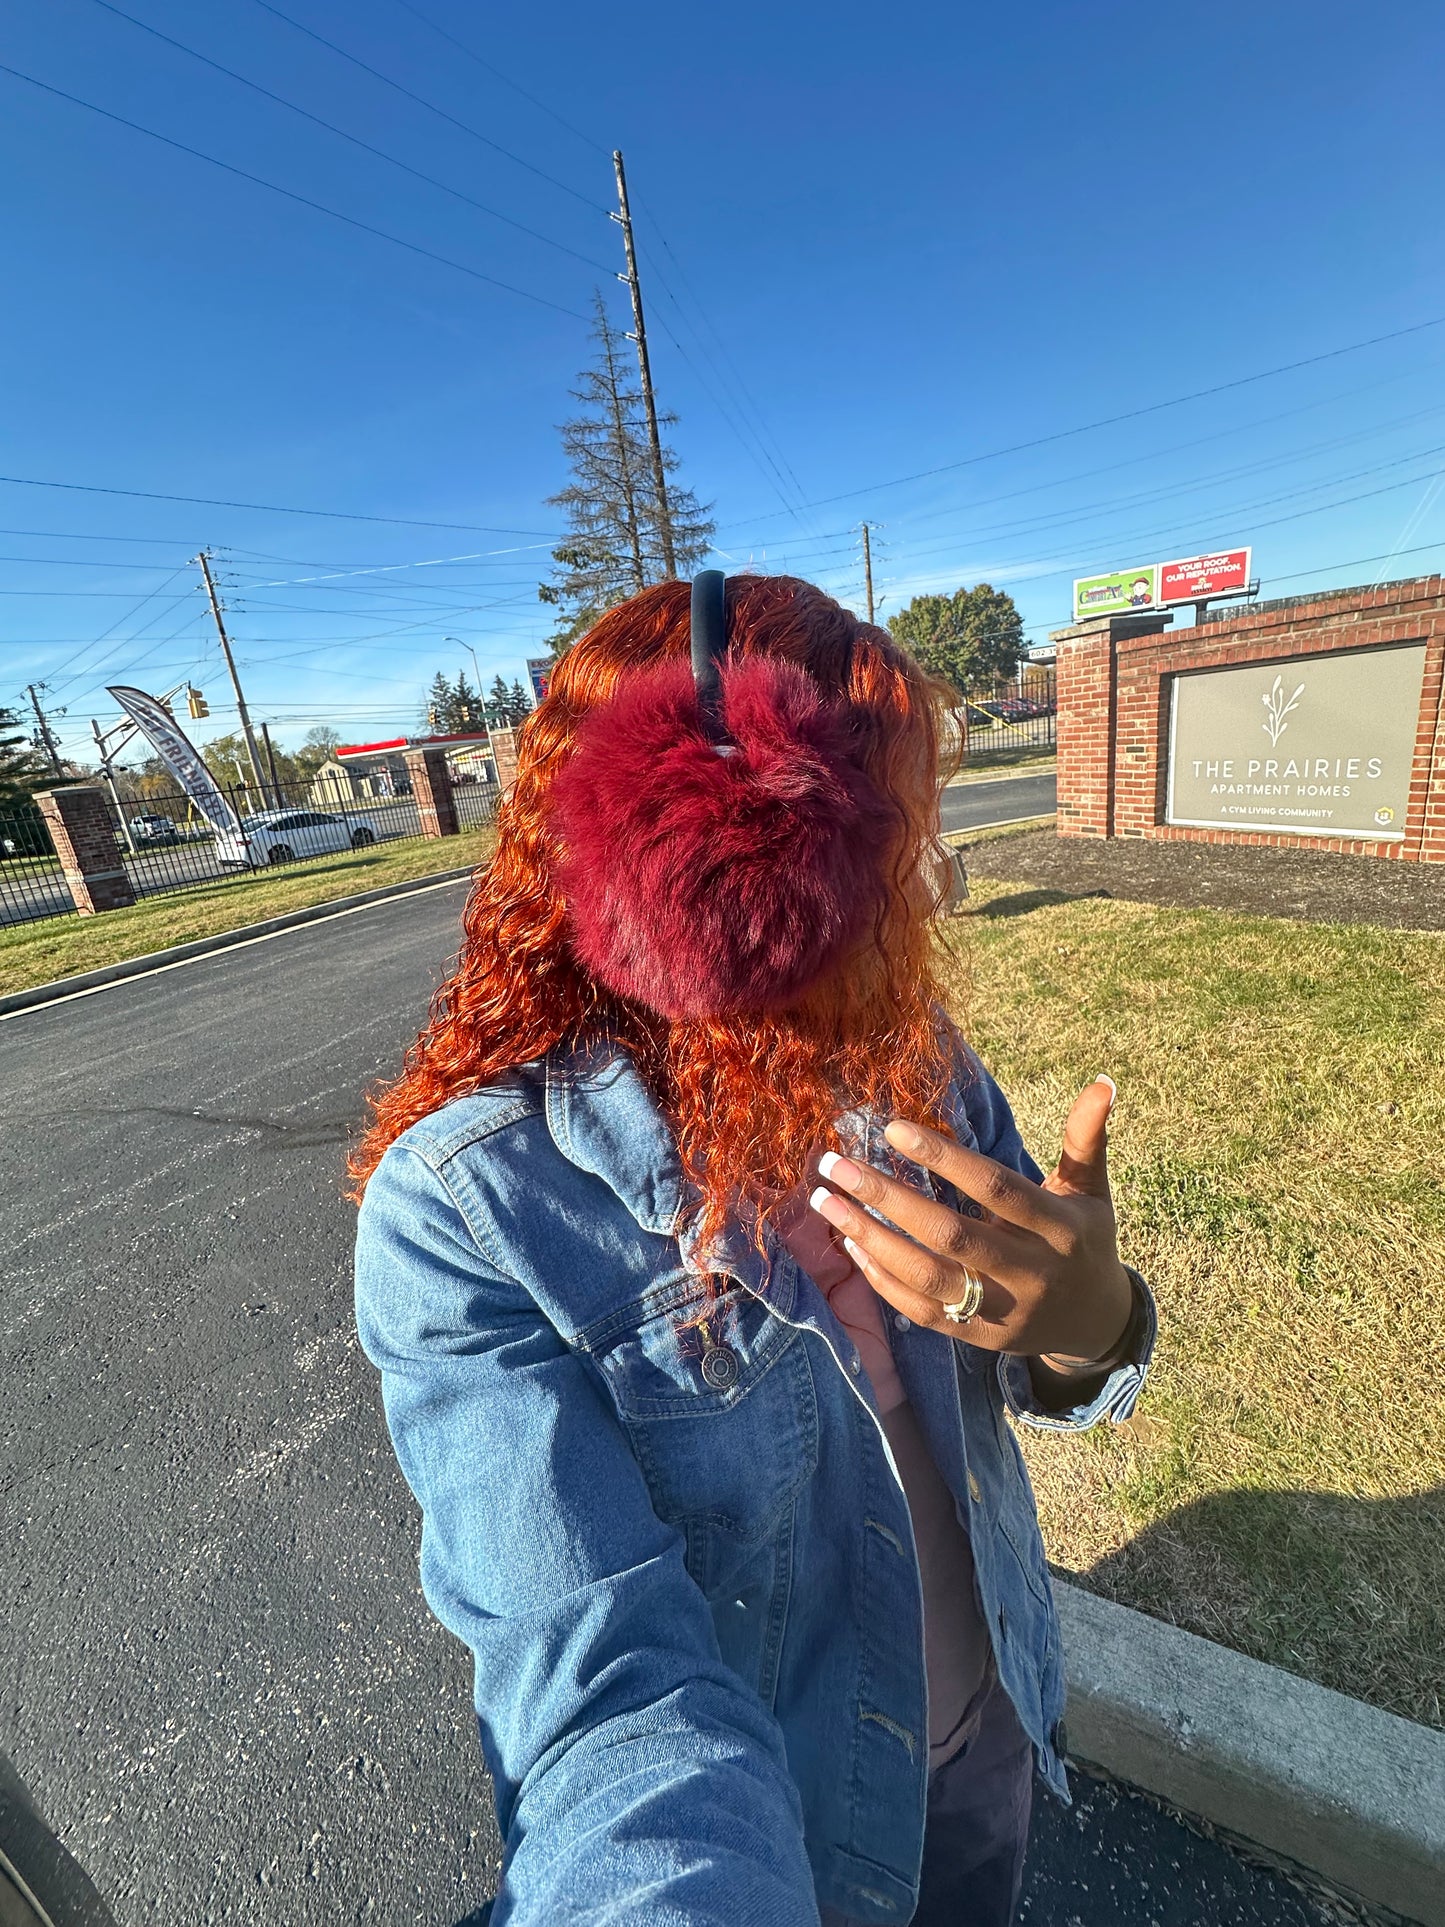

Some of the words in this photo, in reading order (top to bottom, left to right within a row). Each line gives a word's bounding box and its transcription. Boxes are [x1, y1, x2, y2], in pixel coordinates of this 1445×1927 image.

[1178, 562, 1202, 572] YOUR
[1203, 557, 1231, 568] ROOF.
[1166, 573, 1185, 582] OUR
[1186, 563, 1242, 579] REPUTATION.
[1192, 760, 1234, 778] THE
[1248, 758, 1382, 779] PRAIRIES
[1210, 784, 1290, 796] APARTMENT
[1297, 784, 1351, 797] HOMES
[1221, 805, 1227, 814] A
[1229, 806, 1247, 814] CYM
[1248, 806, 1277, 816] LIVING
[1278, 807, 1334, 818] COMMUNITY
